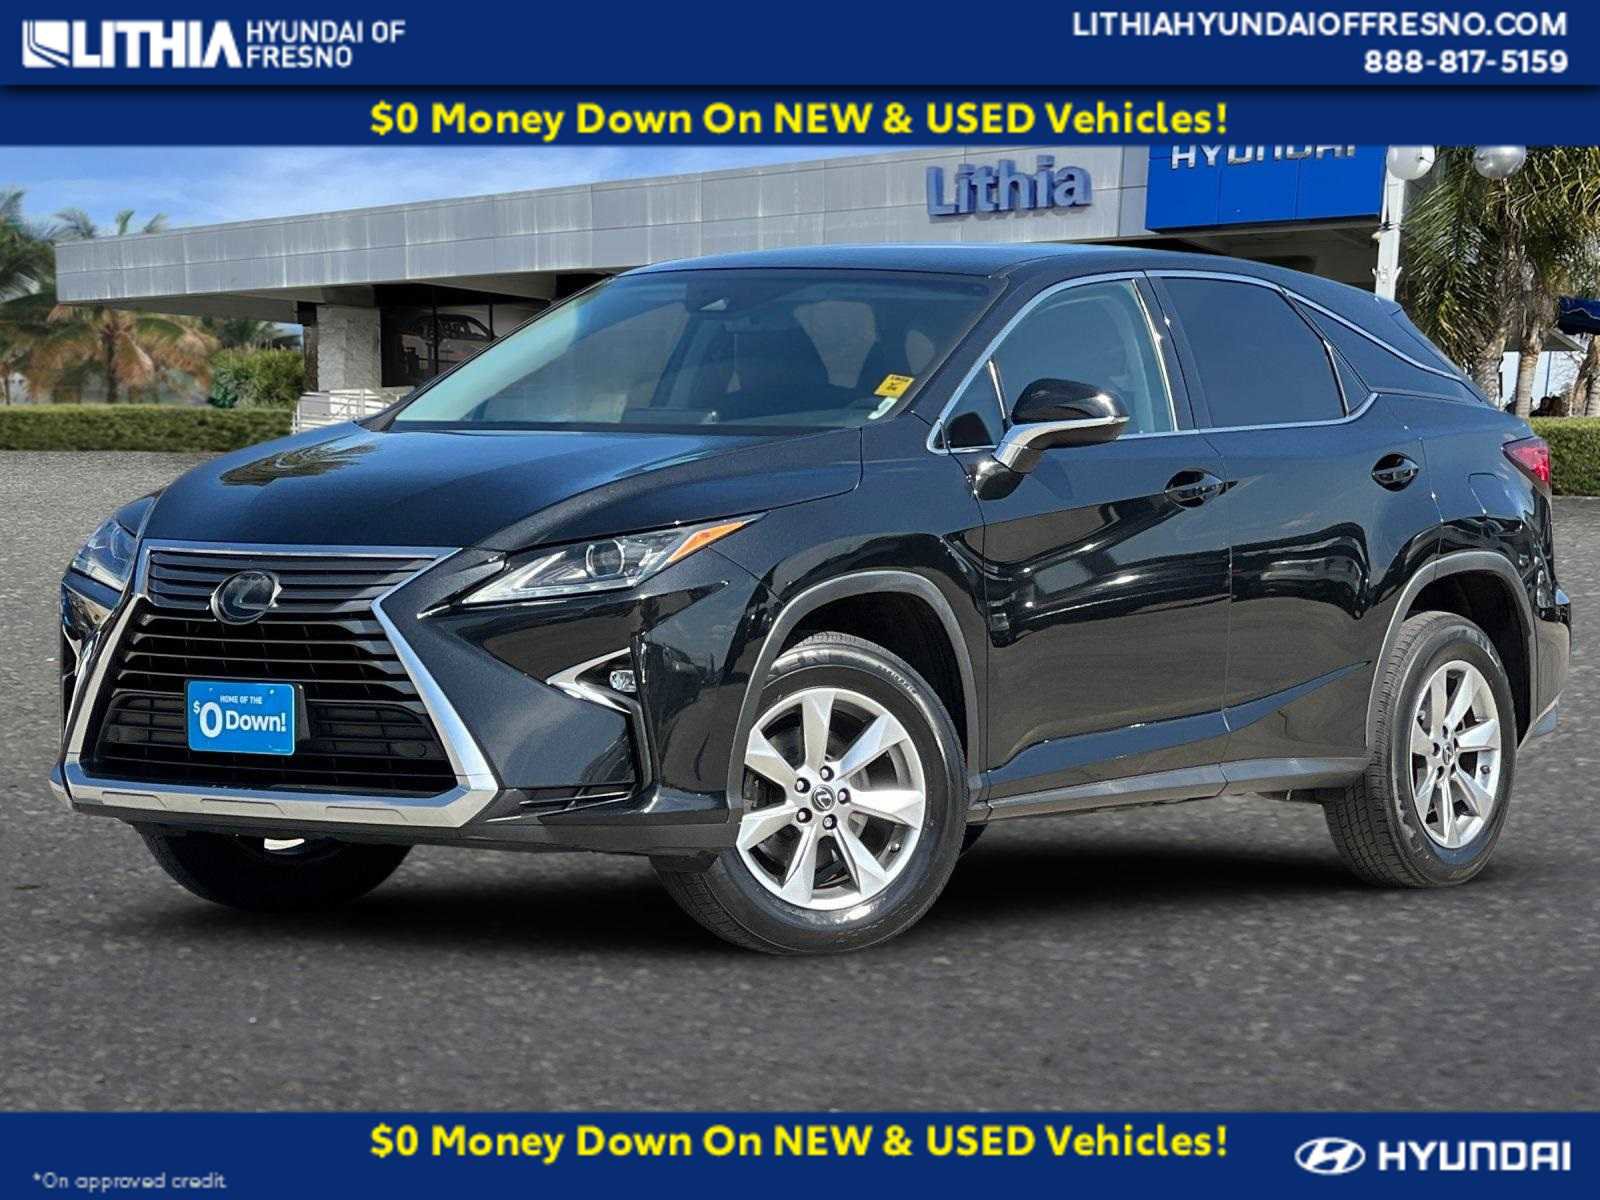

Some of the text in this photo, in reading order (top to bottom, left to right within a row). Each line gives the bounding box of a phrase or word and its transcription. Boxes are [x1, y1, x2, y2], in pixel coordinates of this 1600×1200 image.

[926, 155, 1093, 216] Lithia
[219, 695, 263, 705] HOME OF THE
[225, 710, 287, 732] Down!
